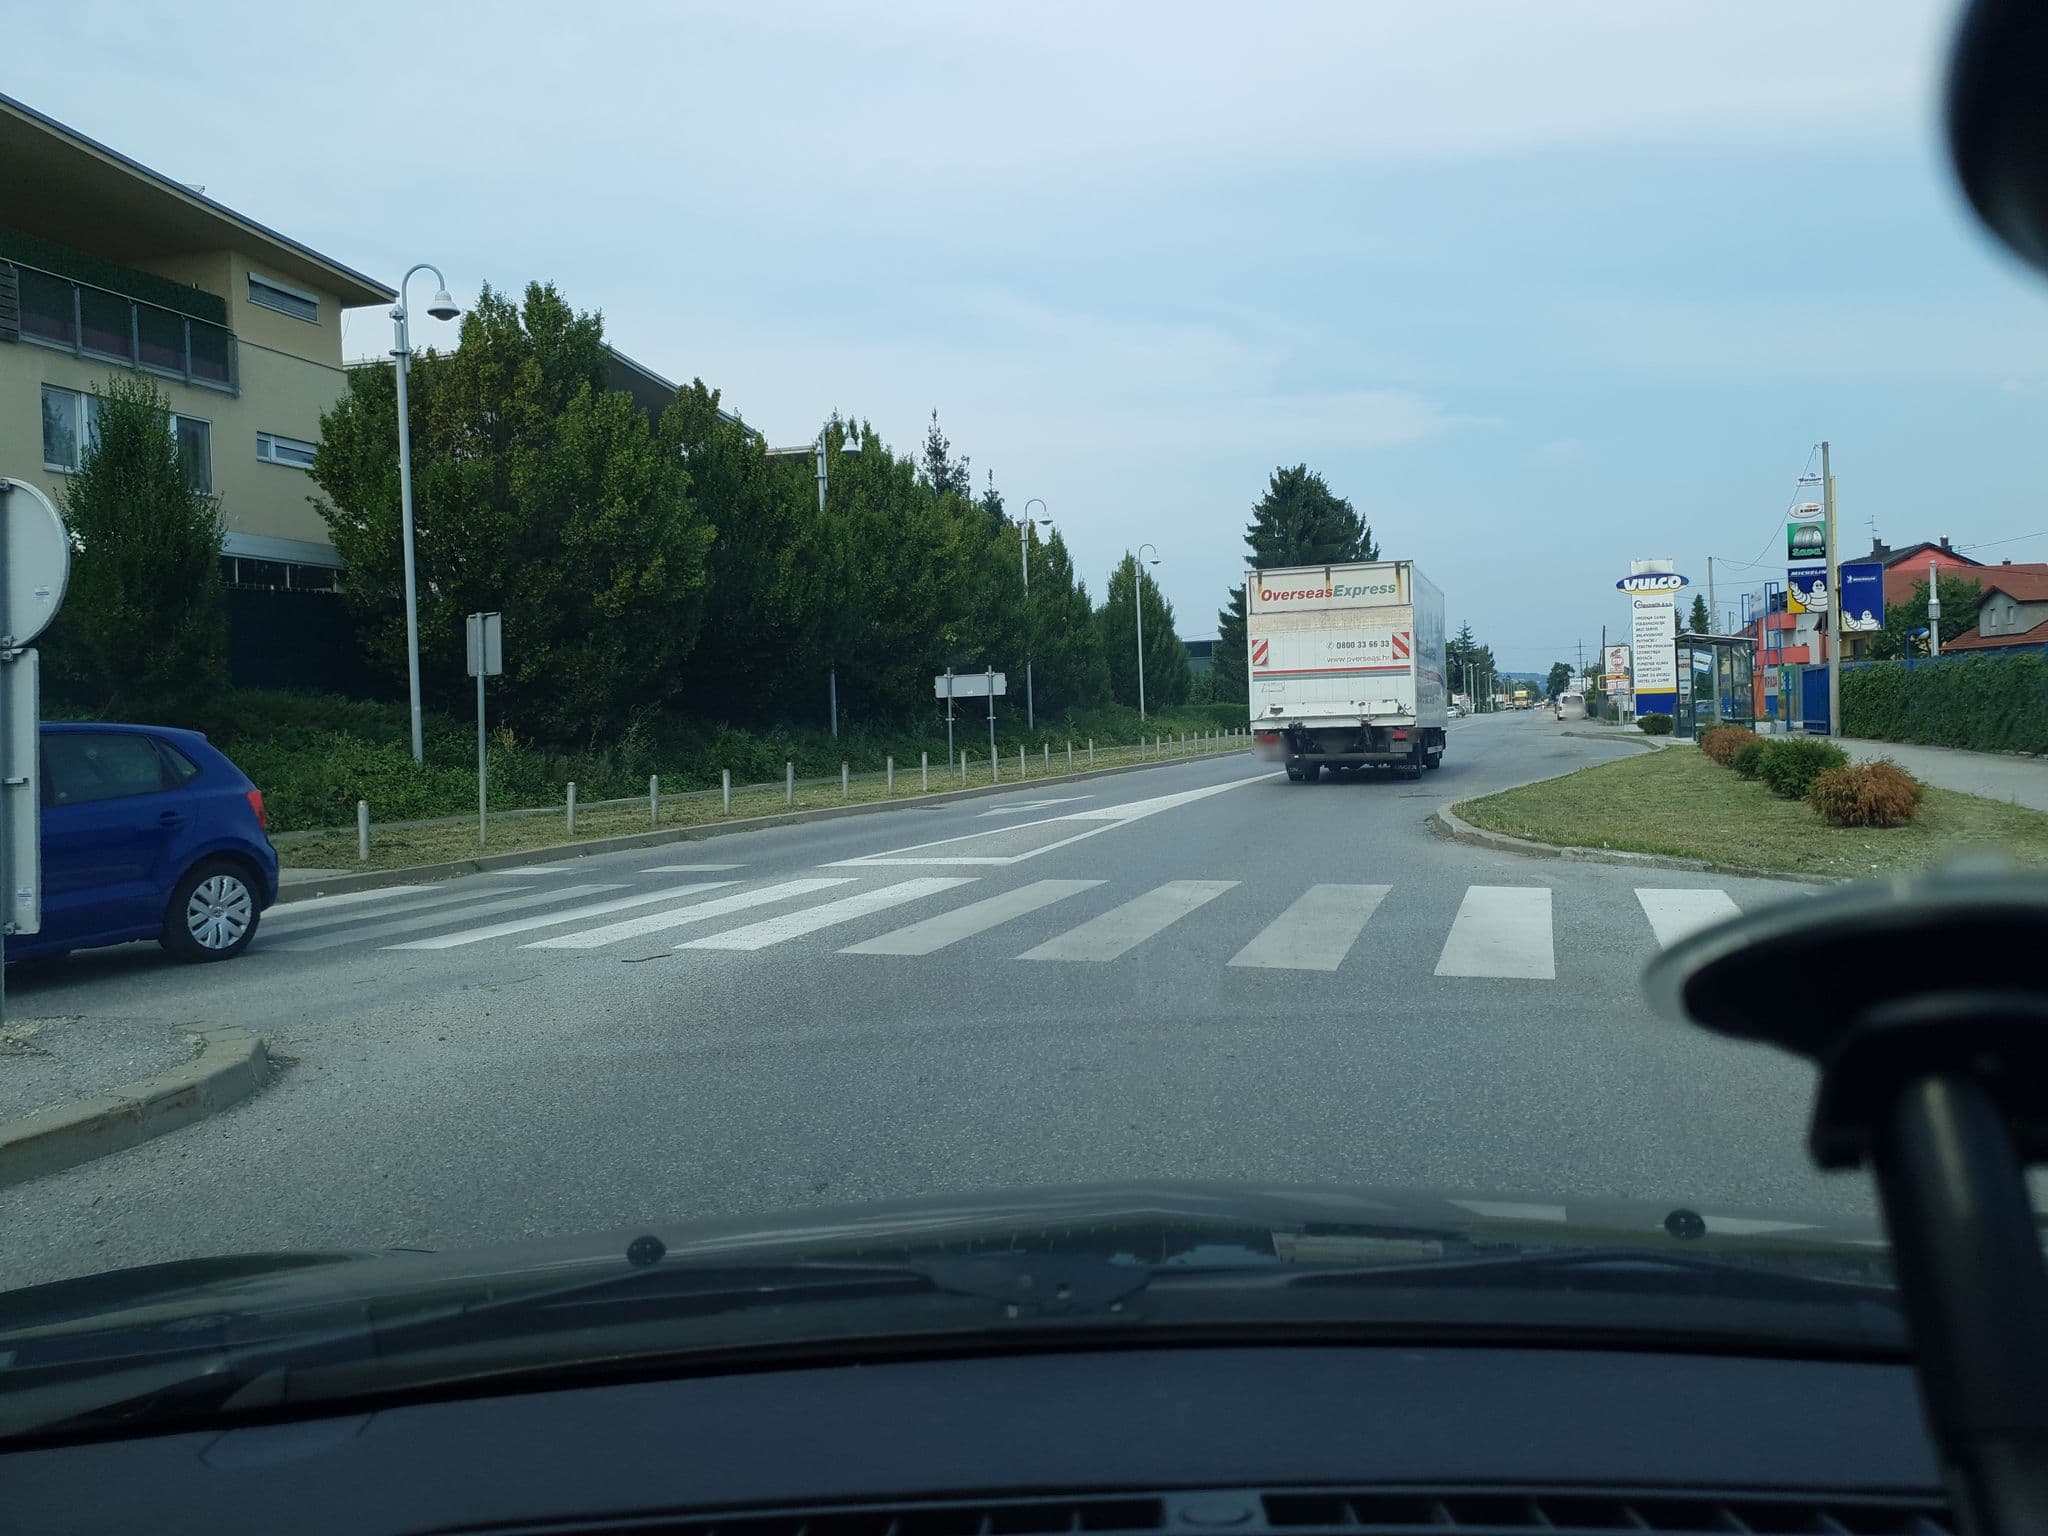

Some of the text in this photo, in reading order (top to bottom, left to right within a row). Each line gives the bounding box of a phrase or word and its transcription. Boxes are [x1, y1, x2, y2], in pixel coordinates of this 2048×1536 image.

[1624, 575, 1682, 591] VULCO
[1261, 584, 1396, 601] OverseasExpress
[1336, 639, 1390, 650] 0800 33 66 33
[1327, 654, 1390, 664] www.overseas.hr
